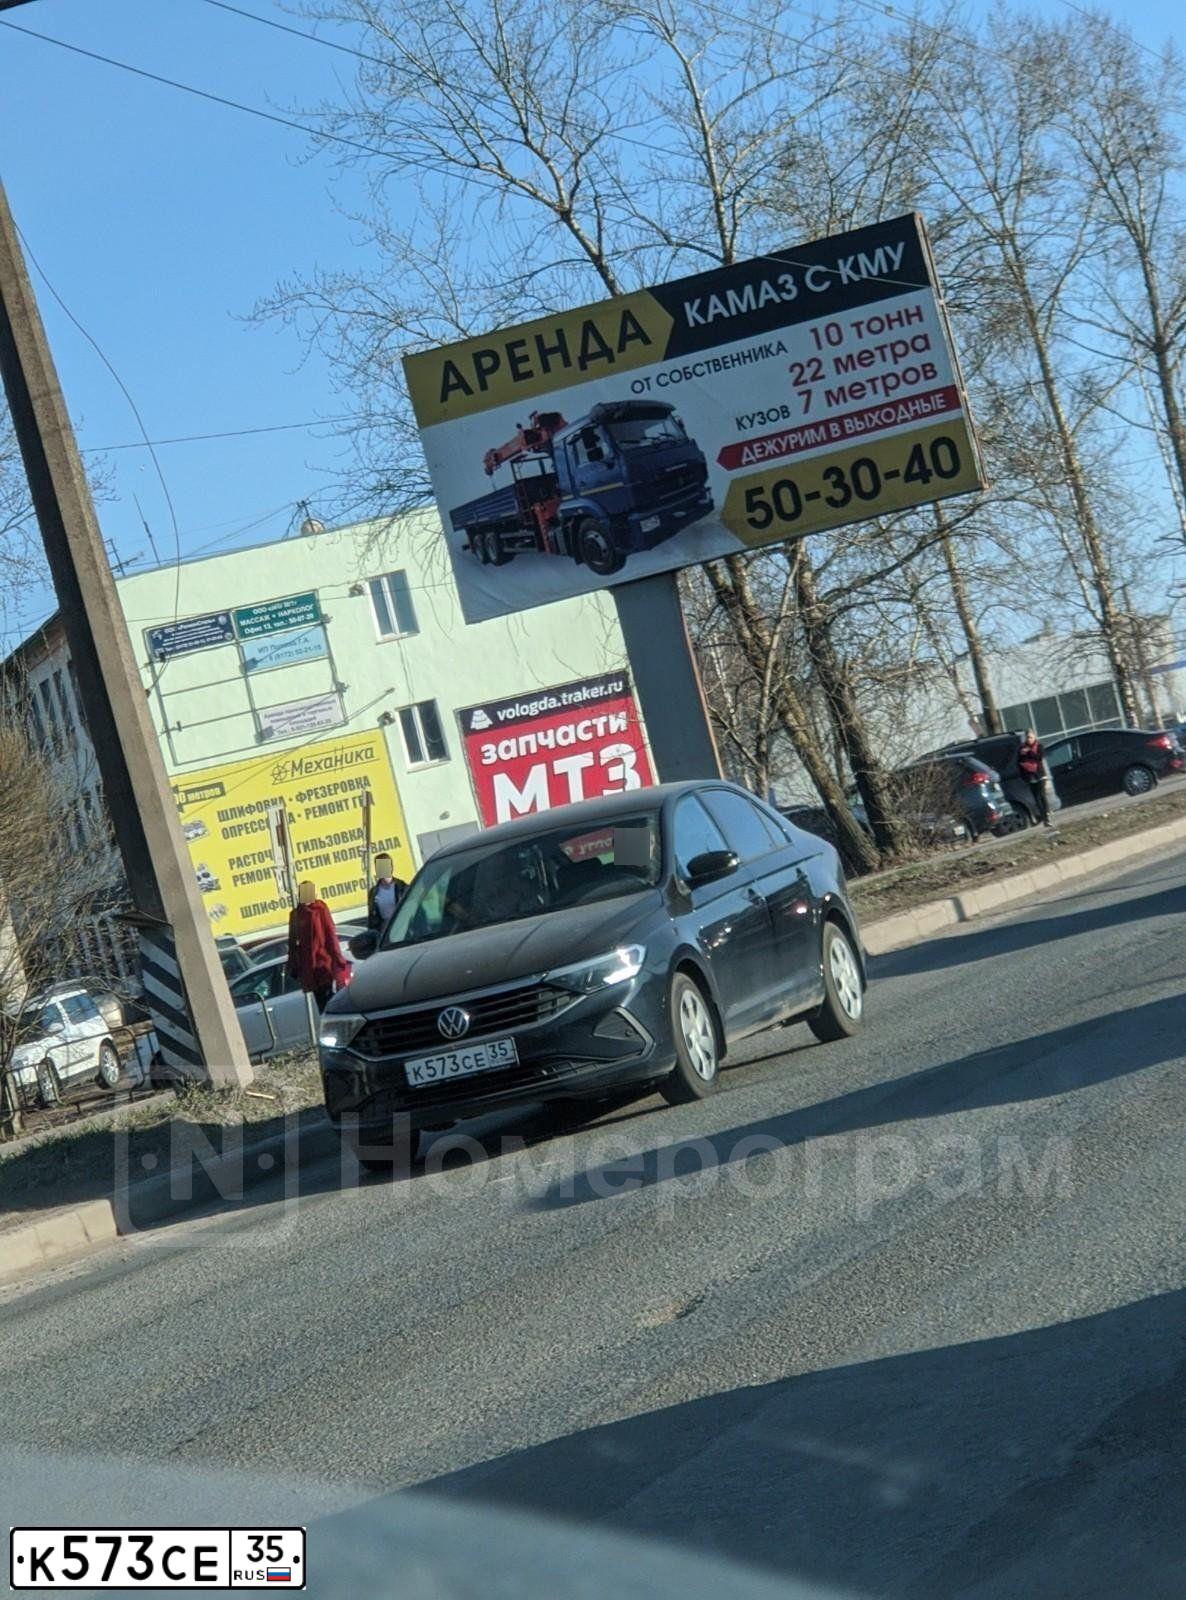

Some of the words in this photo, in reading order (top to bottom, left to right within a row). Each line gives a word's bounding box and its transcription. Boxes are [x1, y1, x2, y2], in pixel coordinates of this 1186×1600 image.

[684, 274, 798, 328] КАМАЗ
[804, 265, 832, 293] С
[837, 241, 905, 284] КМУ
[810, 322, 843, 351] 10
[850, 305, 924, 339] тонн
[439, 308, 653, 404] АРЕНДА
[630, 376, 652, 394] ОТ
[656, 340, 788, 388] СОБСТВЕННИКА
[789, 357, 826, 388] 22
[833, 331, 931, 376] метра
[735, 404, 792, 432] КУЗОВ
[797, 389, 814, 415] 7
[824, 362, 938, 408] метров
[741, 427, 827, 465] ДЕЖУРИМ
[830, 422, 842, 437] В
[845, 393, 946, 434] ВЫХОДНЫЕ
[744, 436, 961, 530] 50-30-40
[239, 614, 271, 627] МАССАЖ
[497, 681, 623, 721] vologda.traker.ru
[291, 747, 374, 777] Механика
[481, 711, 627, 765] запчасти
[217, 796, 286, 822] ШЛИФОВКА
[295, 776, 371, 803] ФРЕЗЕРОВКА
[304, 800, 351, 821] РЕМОНТ
[493, 743, 641, 824] МТЗ
[296, 827, 364, 854] ГИЛЬЗОВКА
